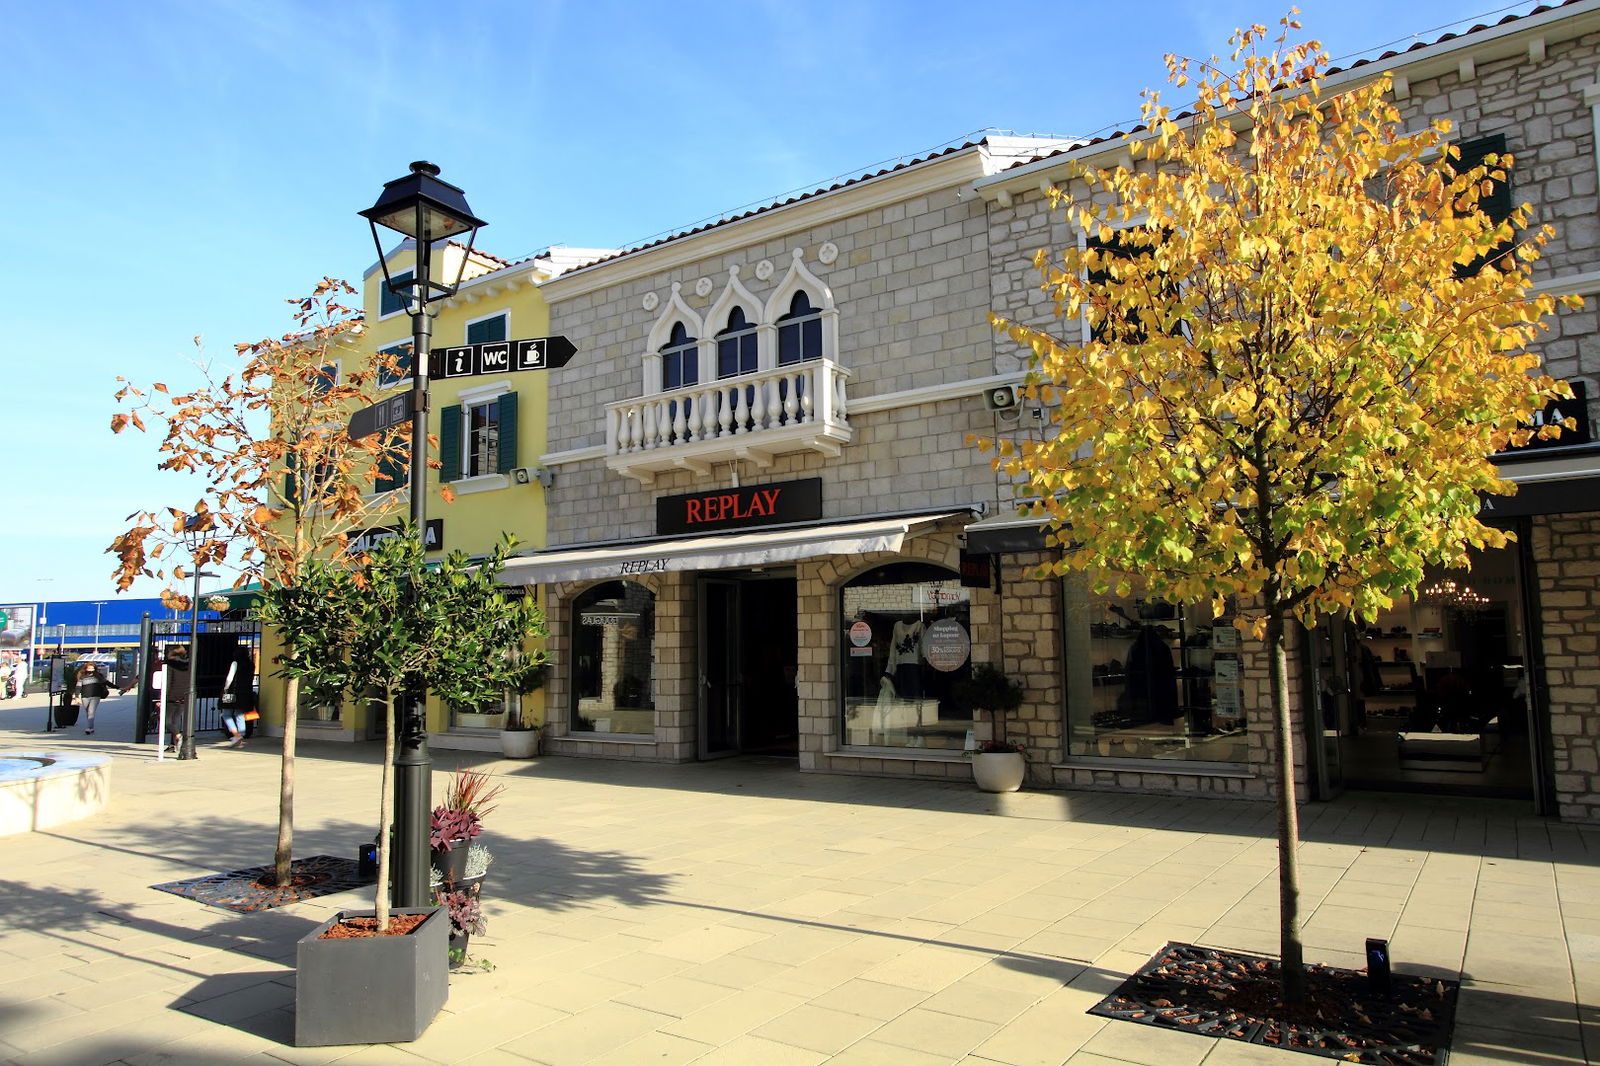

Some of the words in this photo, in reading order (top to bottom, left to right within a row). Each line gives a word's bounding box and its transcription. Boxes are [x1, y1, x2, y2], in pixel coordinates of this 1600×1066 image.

[483, 350, 507, 366] WC
[686, 488, 781, 524] REPLAY
[620, 558, 670, 574] REPLAY
